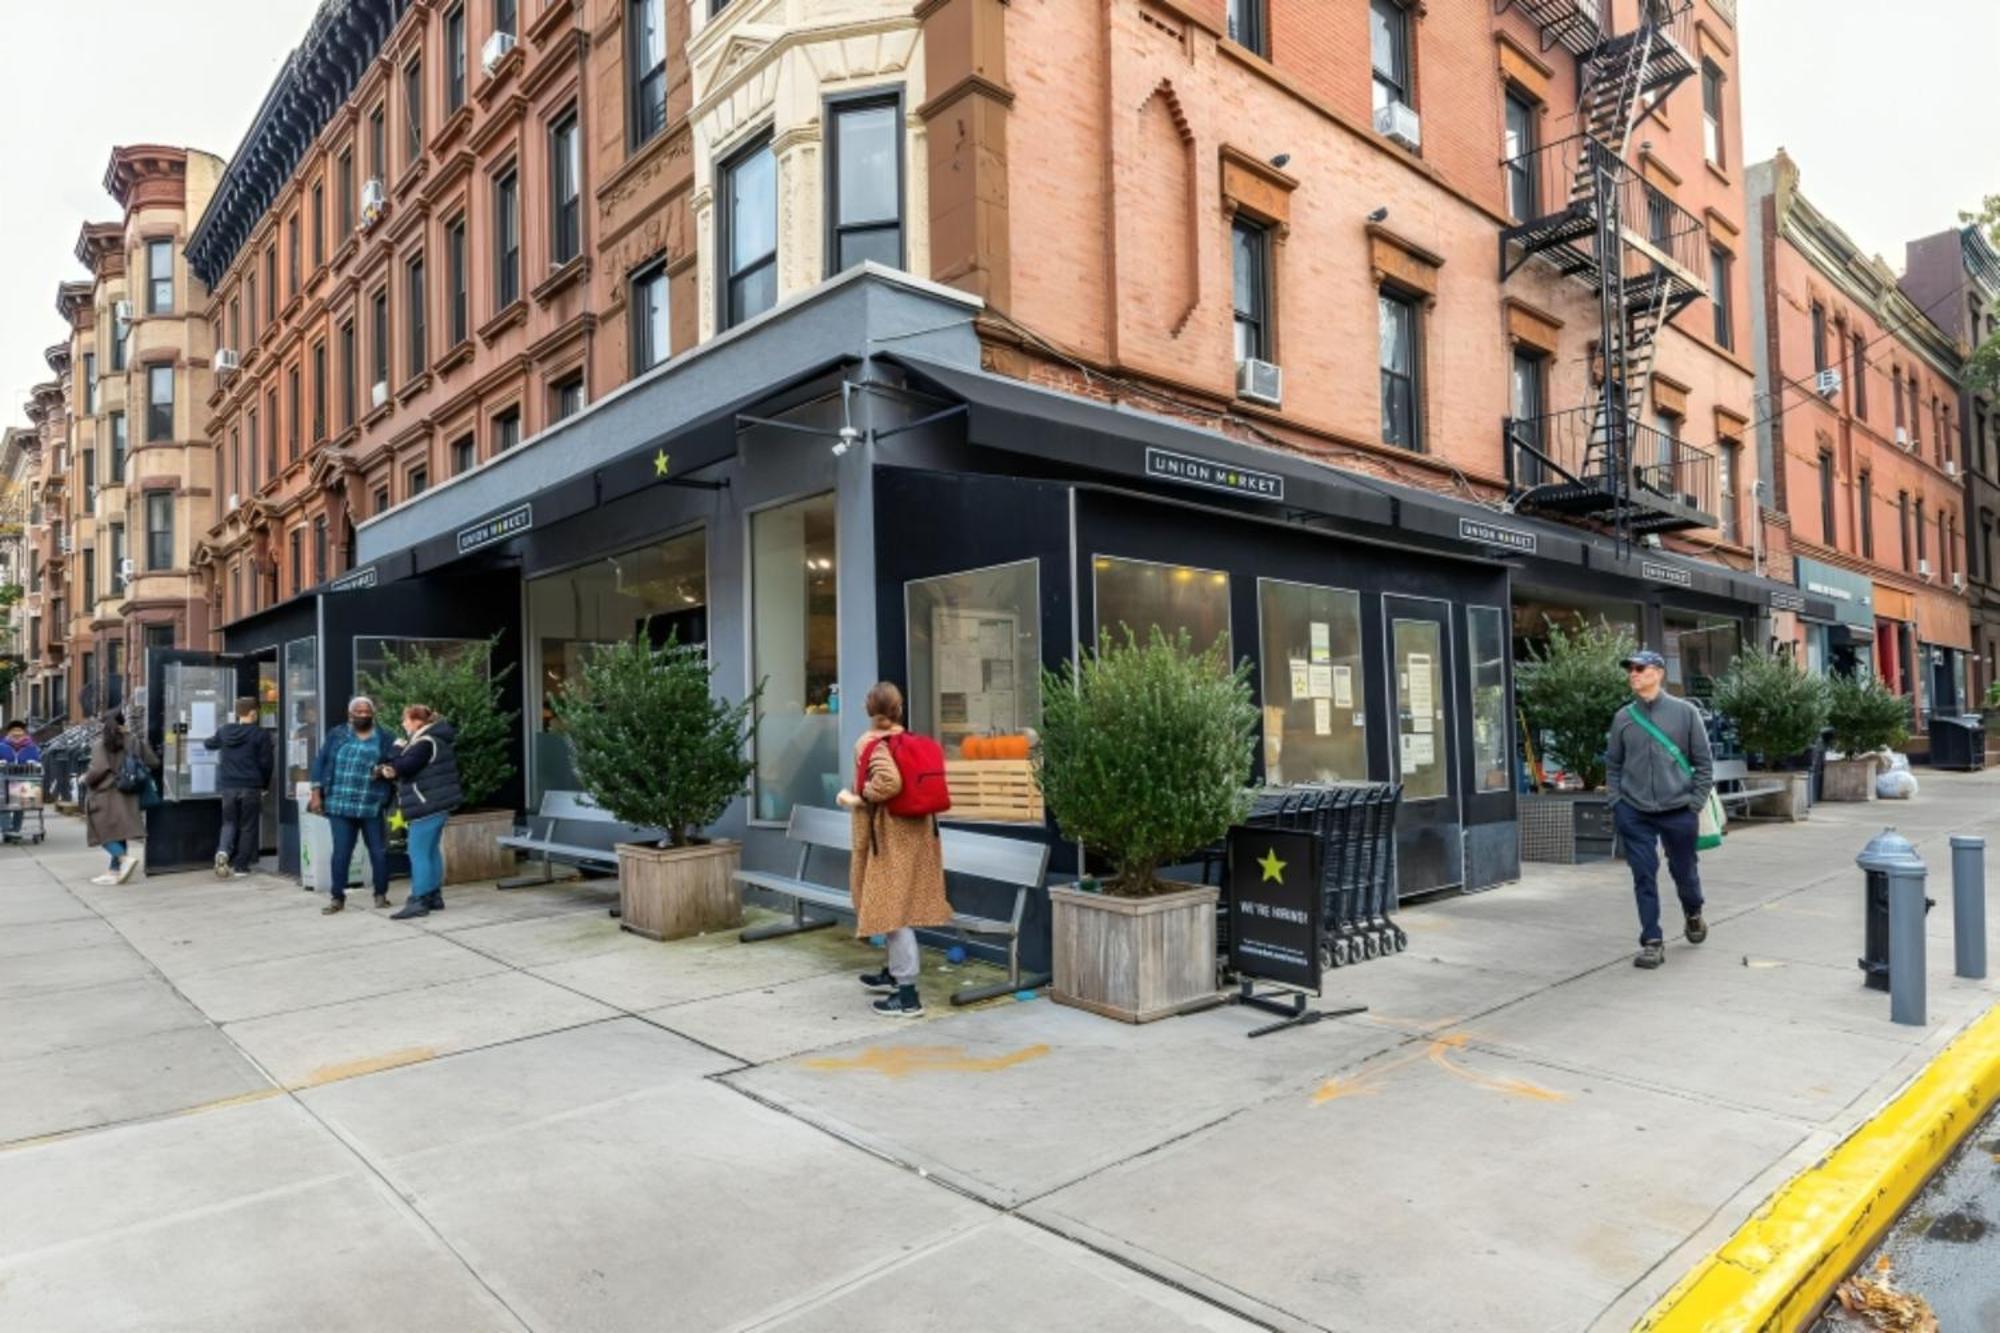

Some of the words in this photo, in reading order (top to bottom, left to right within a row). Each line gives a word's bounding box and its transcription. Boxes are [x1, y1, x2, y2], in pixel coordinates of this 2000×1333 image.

[1155, 456, 1210, 480] UNION
[1215, 470, 1275, 493] MRKET
[490, 511, 527, 536] MRKET
[1497, 531, 1532, 549] MRKET
[1241, 900, 1270, 918] WE'RE
